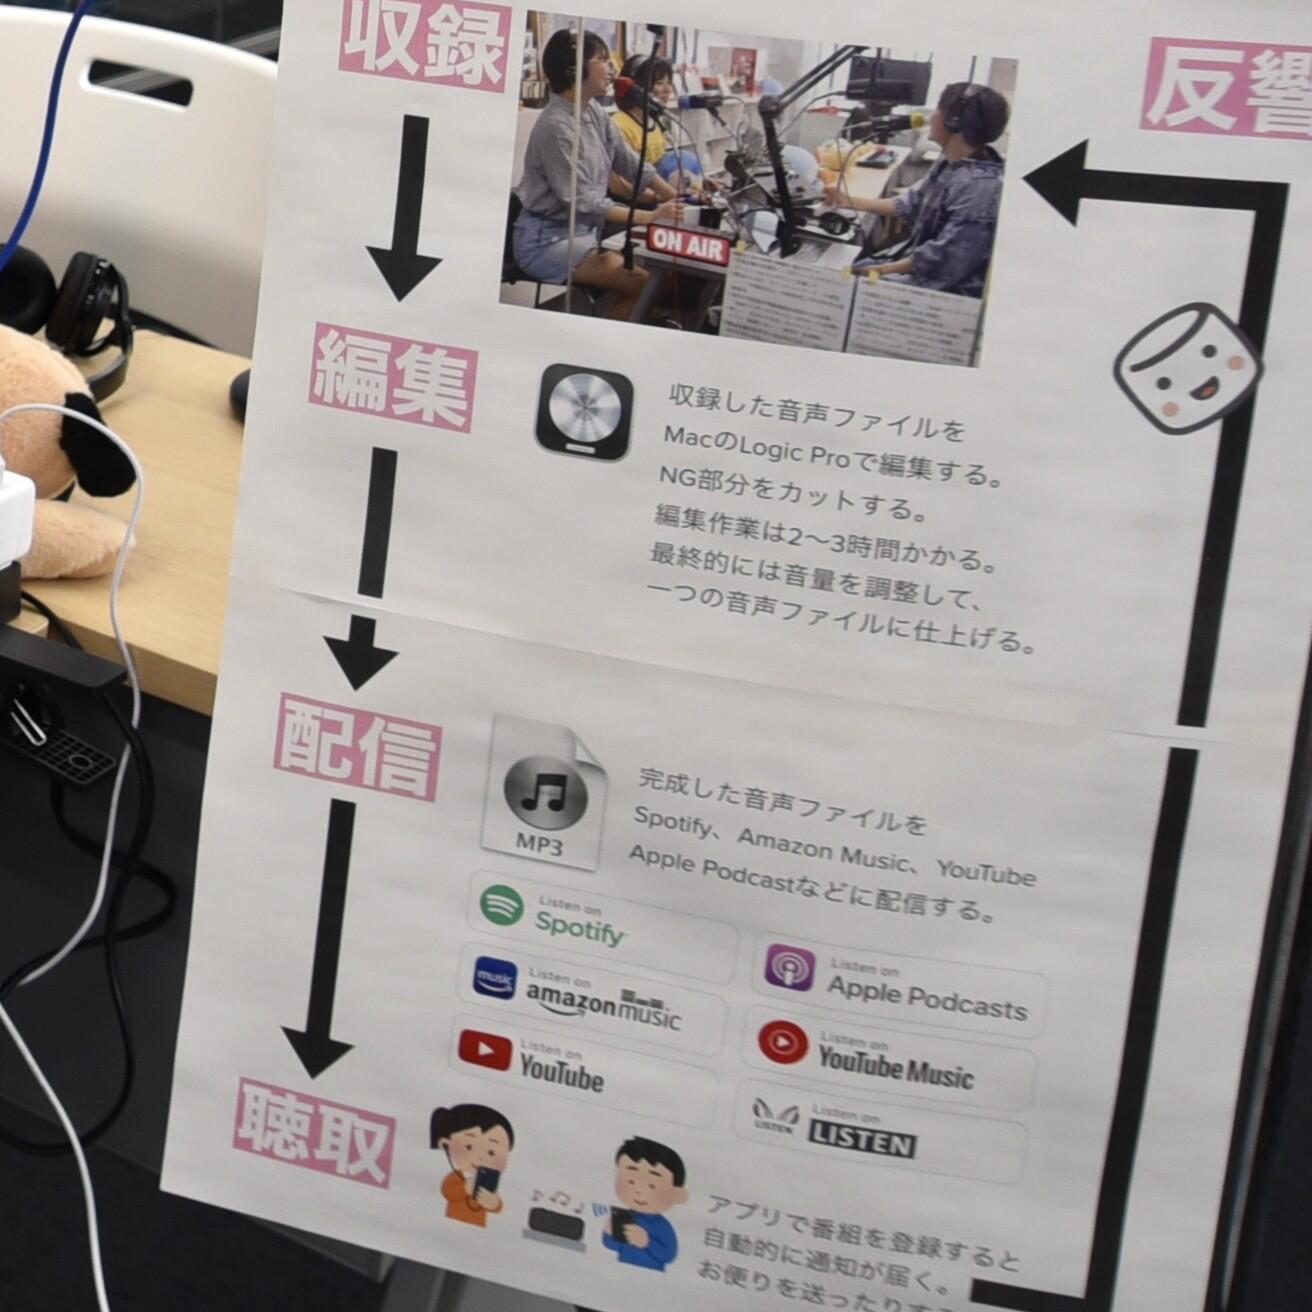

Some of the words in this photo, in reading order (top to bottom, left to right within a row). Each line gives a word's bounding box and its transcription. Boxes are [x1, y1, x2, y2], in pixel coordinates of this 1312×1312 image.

[1145, 44, 1312, 134] 反響
[653, 228, 683, 253] ON
[686, 235, 723, 261] AIR
[313, 329, 470, 427] 編集
[667, 382, 968, 444] 収録した音声ファイルを
[664, 424, 805, 464] MacのLogic
[809, 444, 1002, 490] Proで編集する。
[659, 465, 927, 524] NG部分をカットする。
[650, 540, 981, 612] 最終的には音量を調整して、
[647, 581, 1036, 657] 一つの音声ファイルに仕上げる。
[280, 699, 437, 797] 配信
[638, 765, 929, 838] 完成した音声ファイルを
[515, 832, 564, 858] MP3
[737, 826, 834, 862] Amazon
[937, 857, 1038, 889] YouTube
[539, 894, 582, 912] Listen
[584, 906, 602, 917] on
[629, 842, 696, 875] Apple
[702, 858, 995, 925] Podcastなどに配信する。
[535, 911, 625, 948] Spotify
[528, 966, 571, 985] Listen
[573, 977, 592, 989] on
[831, 957, 878, 976] Listen
[880, 967, 900, 978] on
[826, 975, 903, 1006] Apple
[906, 987, 1029, 1022] Podcasts
[519, 1038, 562, 1057] Listen
[519, 1052, 605, 1094] YouTube
[819, 1043, 904, 1080] YouTube
[906, 1059, 976, 1091] Music
[237, 1083, 391, 1186] 聴取
[754, 1119, 794, 1135] LISTEN
[813, 1121, 915, 1158] LISTEN
[702, 1225, 950, 1296] 自動的に通知が届く。
[707, 1194, 1021, 1274] アプリで番組を登録すると
